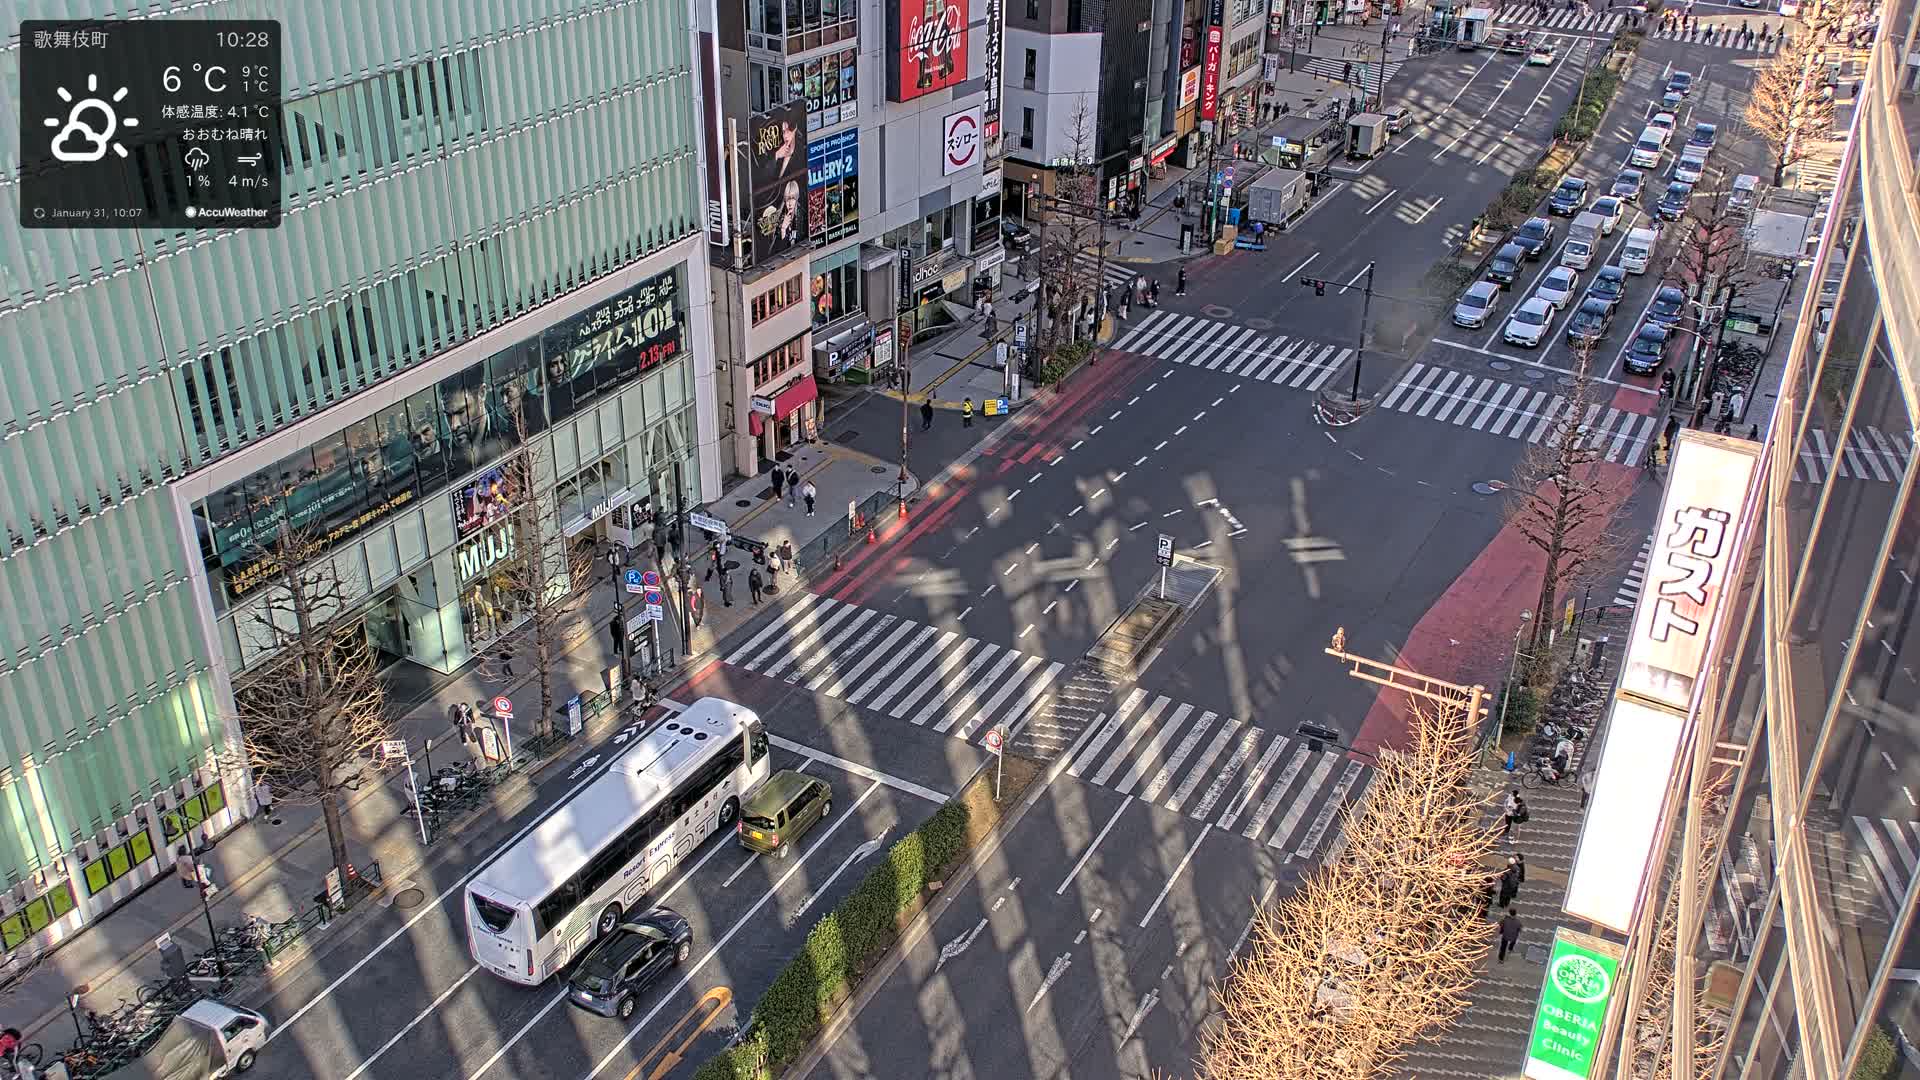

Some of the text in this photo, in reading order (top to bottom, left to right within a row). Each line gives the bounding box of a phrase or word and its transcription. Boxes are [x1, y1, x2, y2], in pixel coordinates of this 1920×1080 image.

[908, 5, 961, 63] Coca-Cola
[1205, 45, 1219, 110] バーガーキング
[823, 88, 851, 107] HALL
[810, 141, 831, 153] SPORTS
[842, 133, 855, 144] SHOP
[946, 133, 978, 152] スシロー
[710, 199, 721, 232] MUJI
[828, 225, 857, 240] BASKETBALL
[902, 251, 909, 259] P
[595, 306, 611, 320] クリス
[618, 295, 633, 309] マーク
[614, 304, 634, 320] ラファロ
[1017, 326, 1025, 335] P
[639, 340, 676, 369] 2.13 FRI
[829, 351, 839, 367] P
[997, 399, 1004, 409] P
[592, 497, 615, 520] MUJI
[459, 523, 516, 581] MUJI
[1160, 540, 1168, 548] P
[1650, 507, 1731, 643] ガスト
[623, 832, 675, 880] Resort Express
[1543, 1004, 1597, 1033] OBERIA
[1543, 1019, 1590, 1047] Beauty
[1542, 1038, 1585, 1062] Clinic
